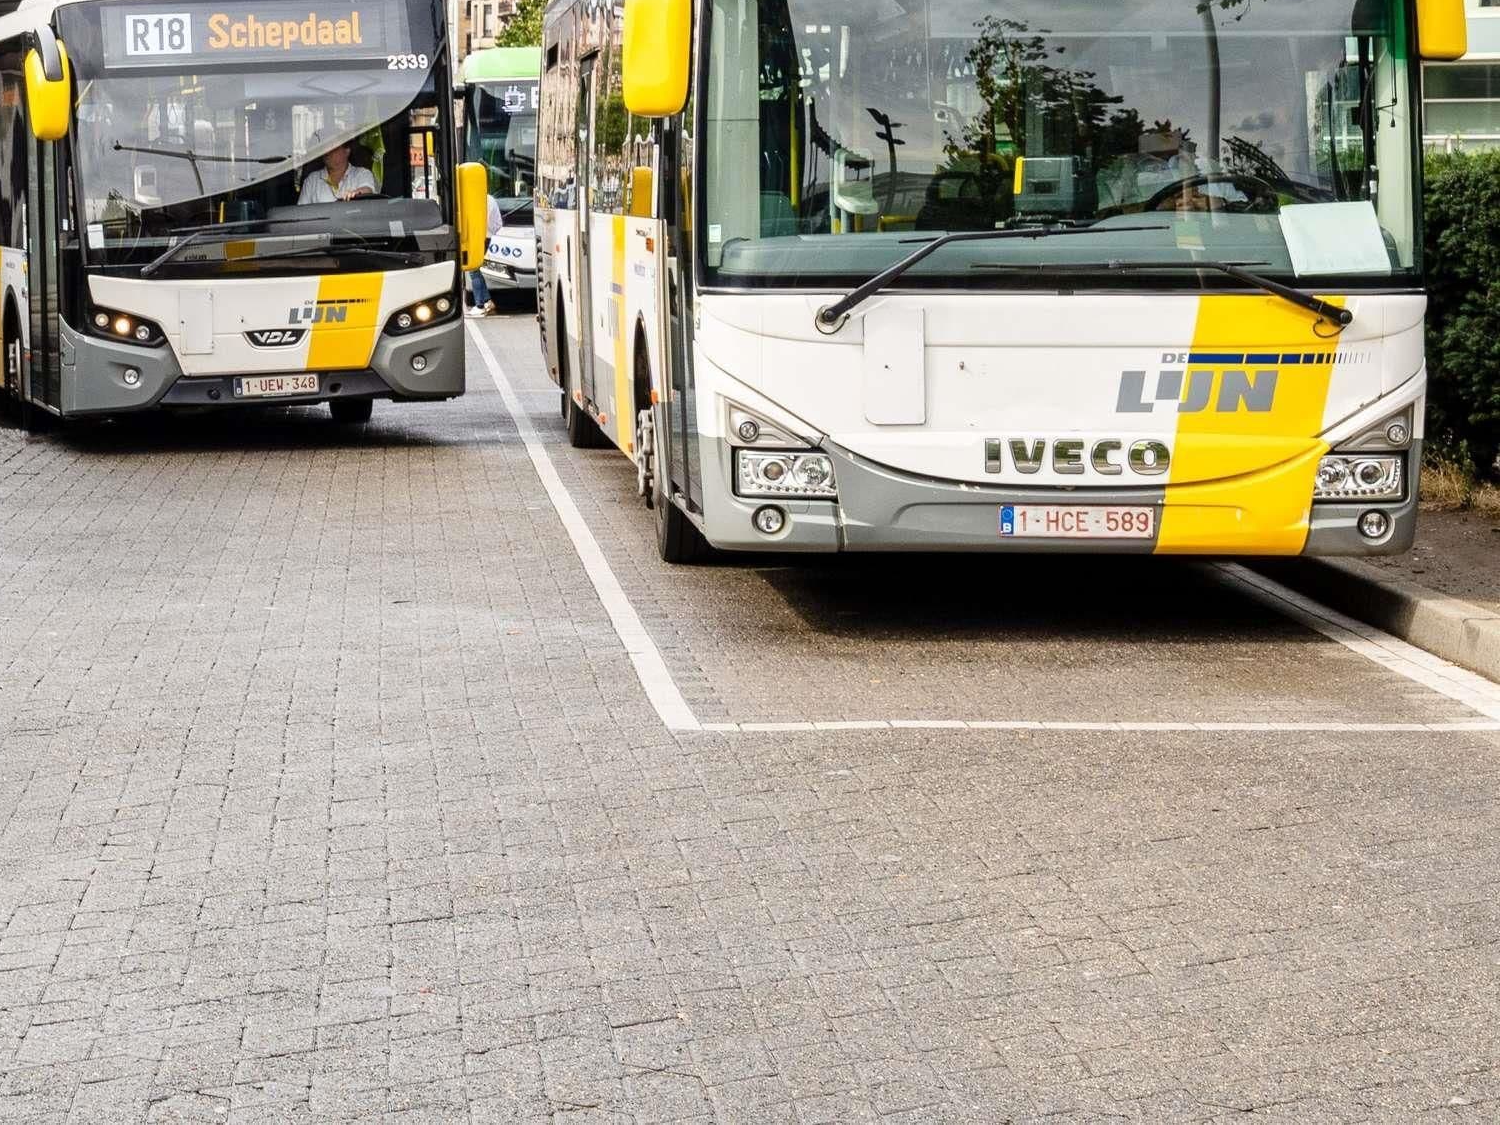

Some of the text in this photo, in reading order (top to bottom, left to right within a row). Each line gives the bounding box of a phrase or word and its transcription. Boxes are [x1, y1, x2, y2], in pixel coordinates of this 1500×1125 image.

[132, 11, 363, 52] R18 Schepdaal
[387, 54, 429, 70] 2339
[288, 306, 348, 325] LIJN
[253, 331, 297, 344] VDL
[1161, 352, 1187, 364] DE
[1115, 370, 1279, 414] LIJN
[984, 437, 1171, 476] IVECO
[1002, 522, 1012, 533] B
